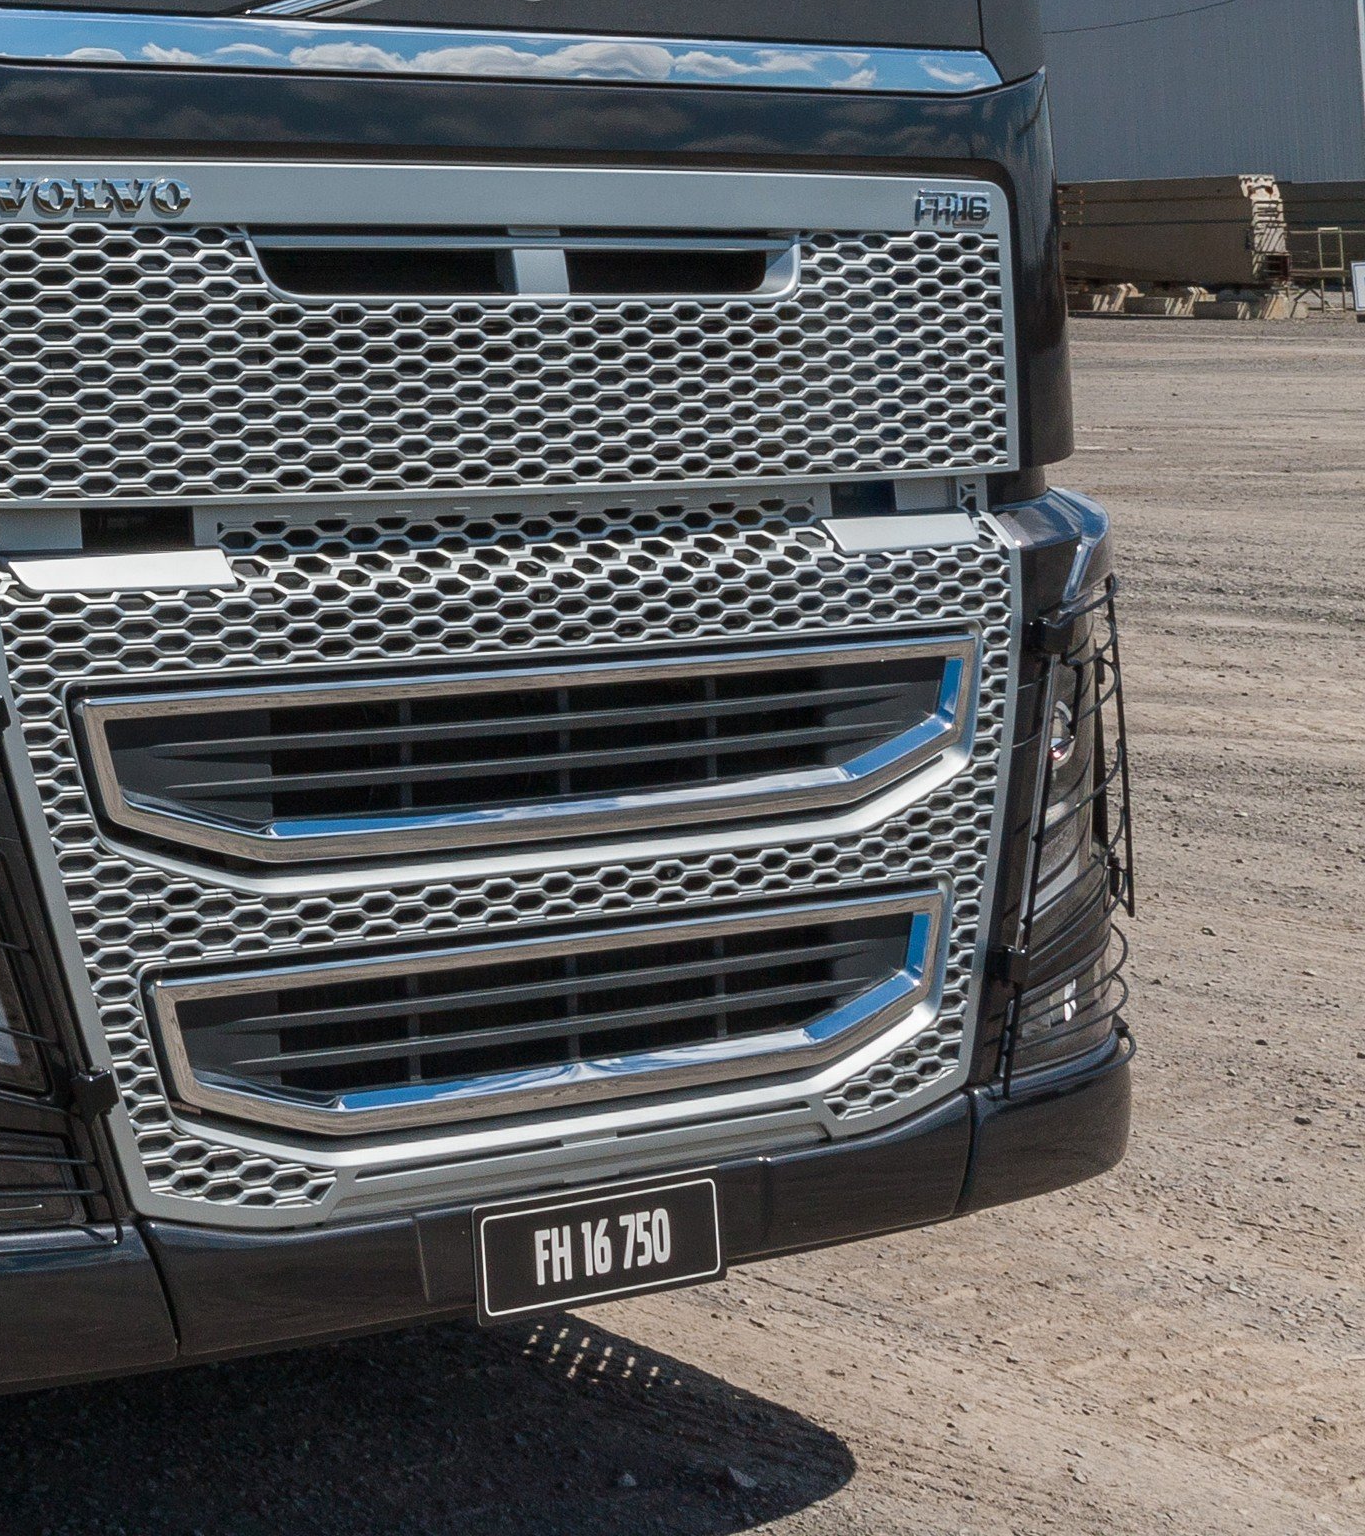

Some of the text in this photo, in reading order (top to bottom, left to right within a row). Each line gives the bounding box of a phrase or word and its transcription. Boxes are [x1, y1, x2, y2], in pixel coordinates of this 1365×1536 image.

[914, 191, 990, 228] FH16
[534, 1208, 671, 1286] FH 16 750
